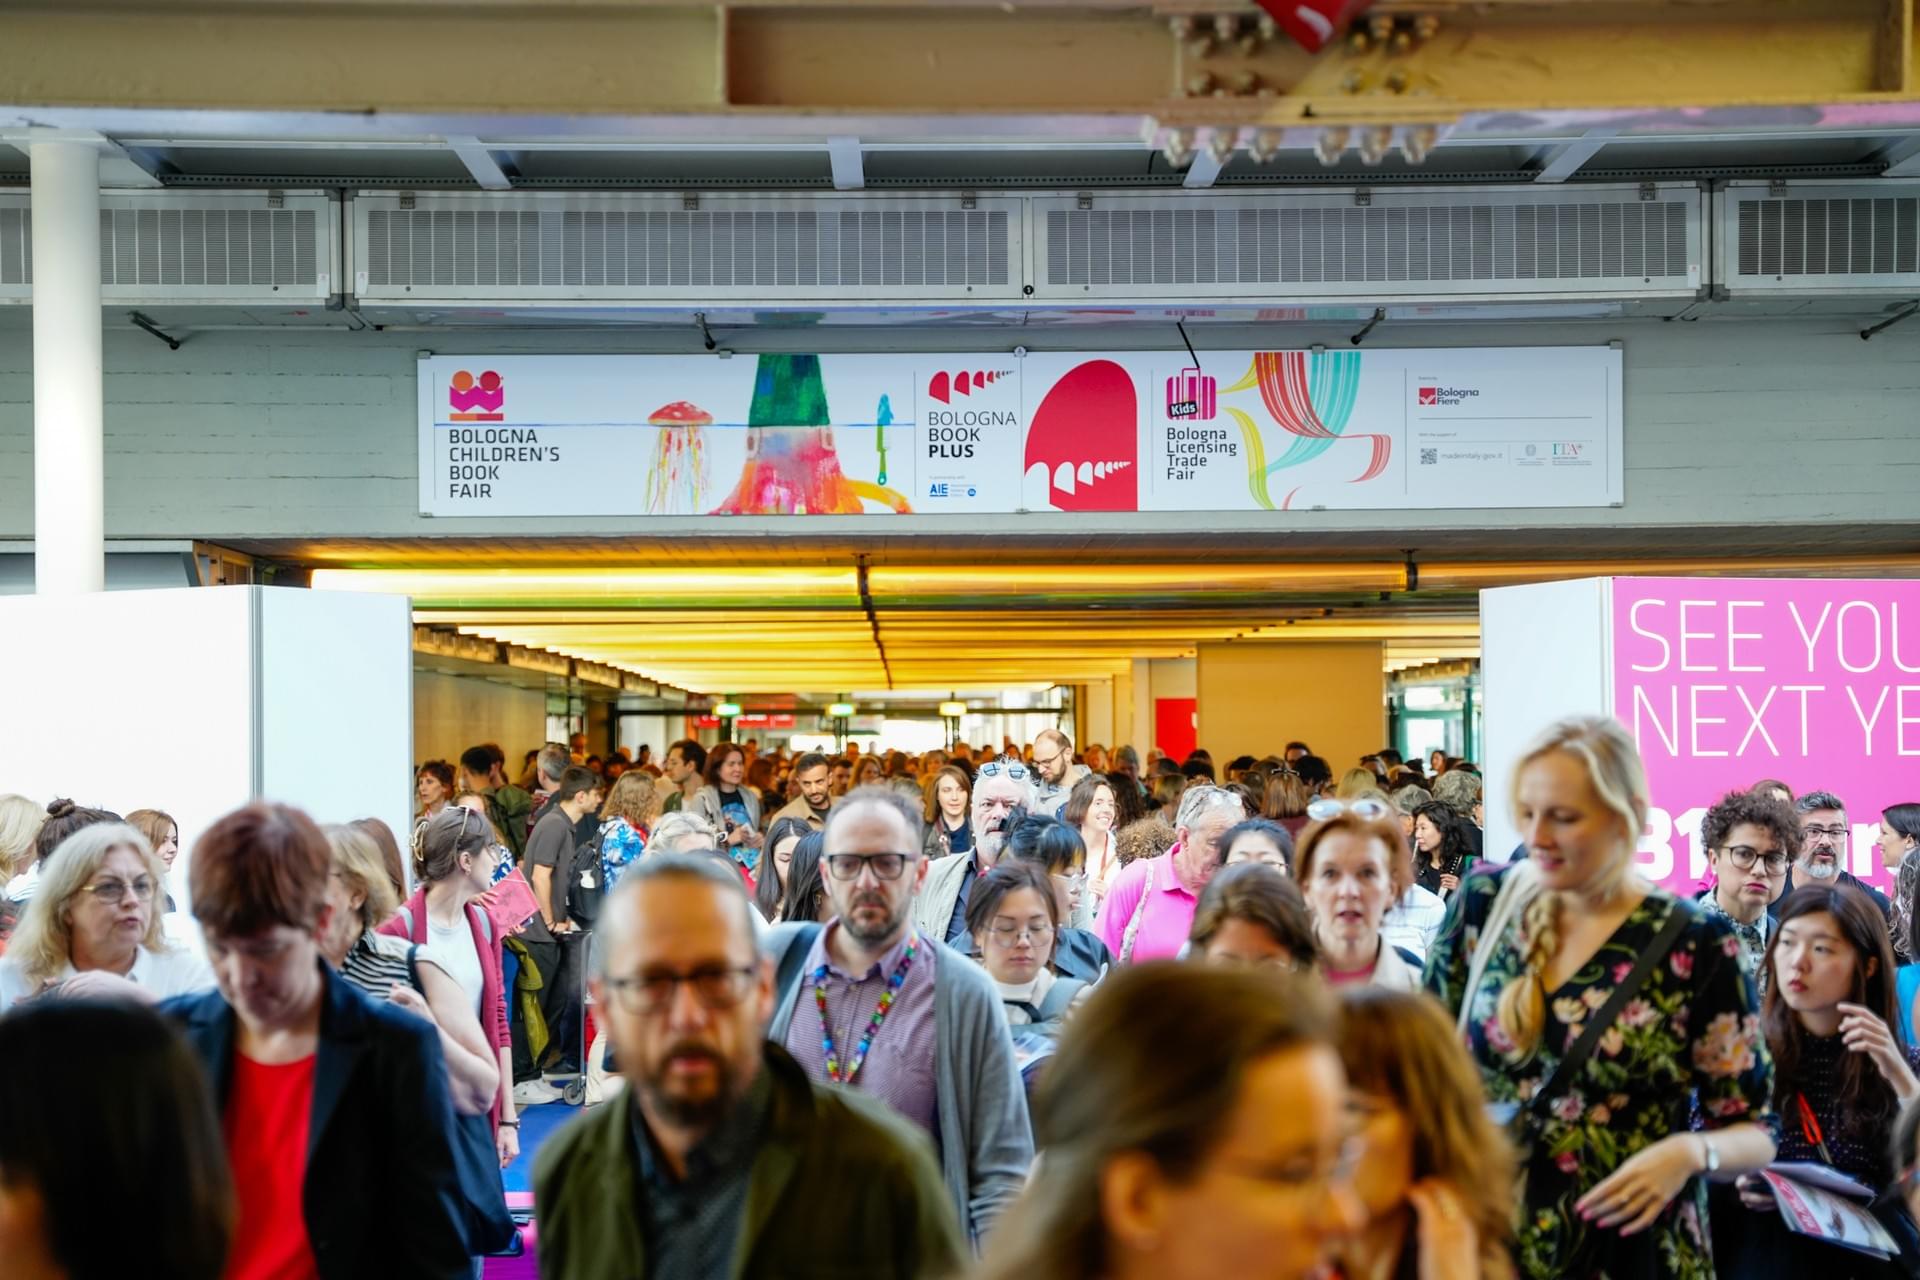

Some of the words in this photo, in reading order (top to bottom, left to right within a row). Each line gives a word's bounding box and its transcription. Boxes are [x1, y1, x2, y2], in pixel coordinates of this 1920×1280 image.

[1437, 387, 1480, 399] Bologna
[1437, 397, 1460, 405] Fiere
[1171, 402, 1197, 416] Kids
[928, 411, 1017, 426] BOLOGNA
[449, 429, 538, 444] BOLOGNA
[929, 427, 980, 442] BOOK
[1167, 427, 1227, 443] Bologna
[449, 446, 560, 462] CHILDREN'S
[929, 444, 975, 458] PLUS
[1167, 441, 1237, 456] Licensing
[1167, 454, 1207, 467] Trade
[449, 465, 500, 480] BOOK
[1167, 467, 1195, 480] Fair
[449, 483, 492, 498] FAIR
[930, 483, 949, 494] AIE
[1630, 599, 1765, 672] SEE
[1788, 600, 1920, 673] YOU
[1633, 684, 1825, 757] NEXT
